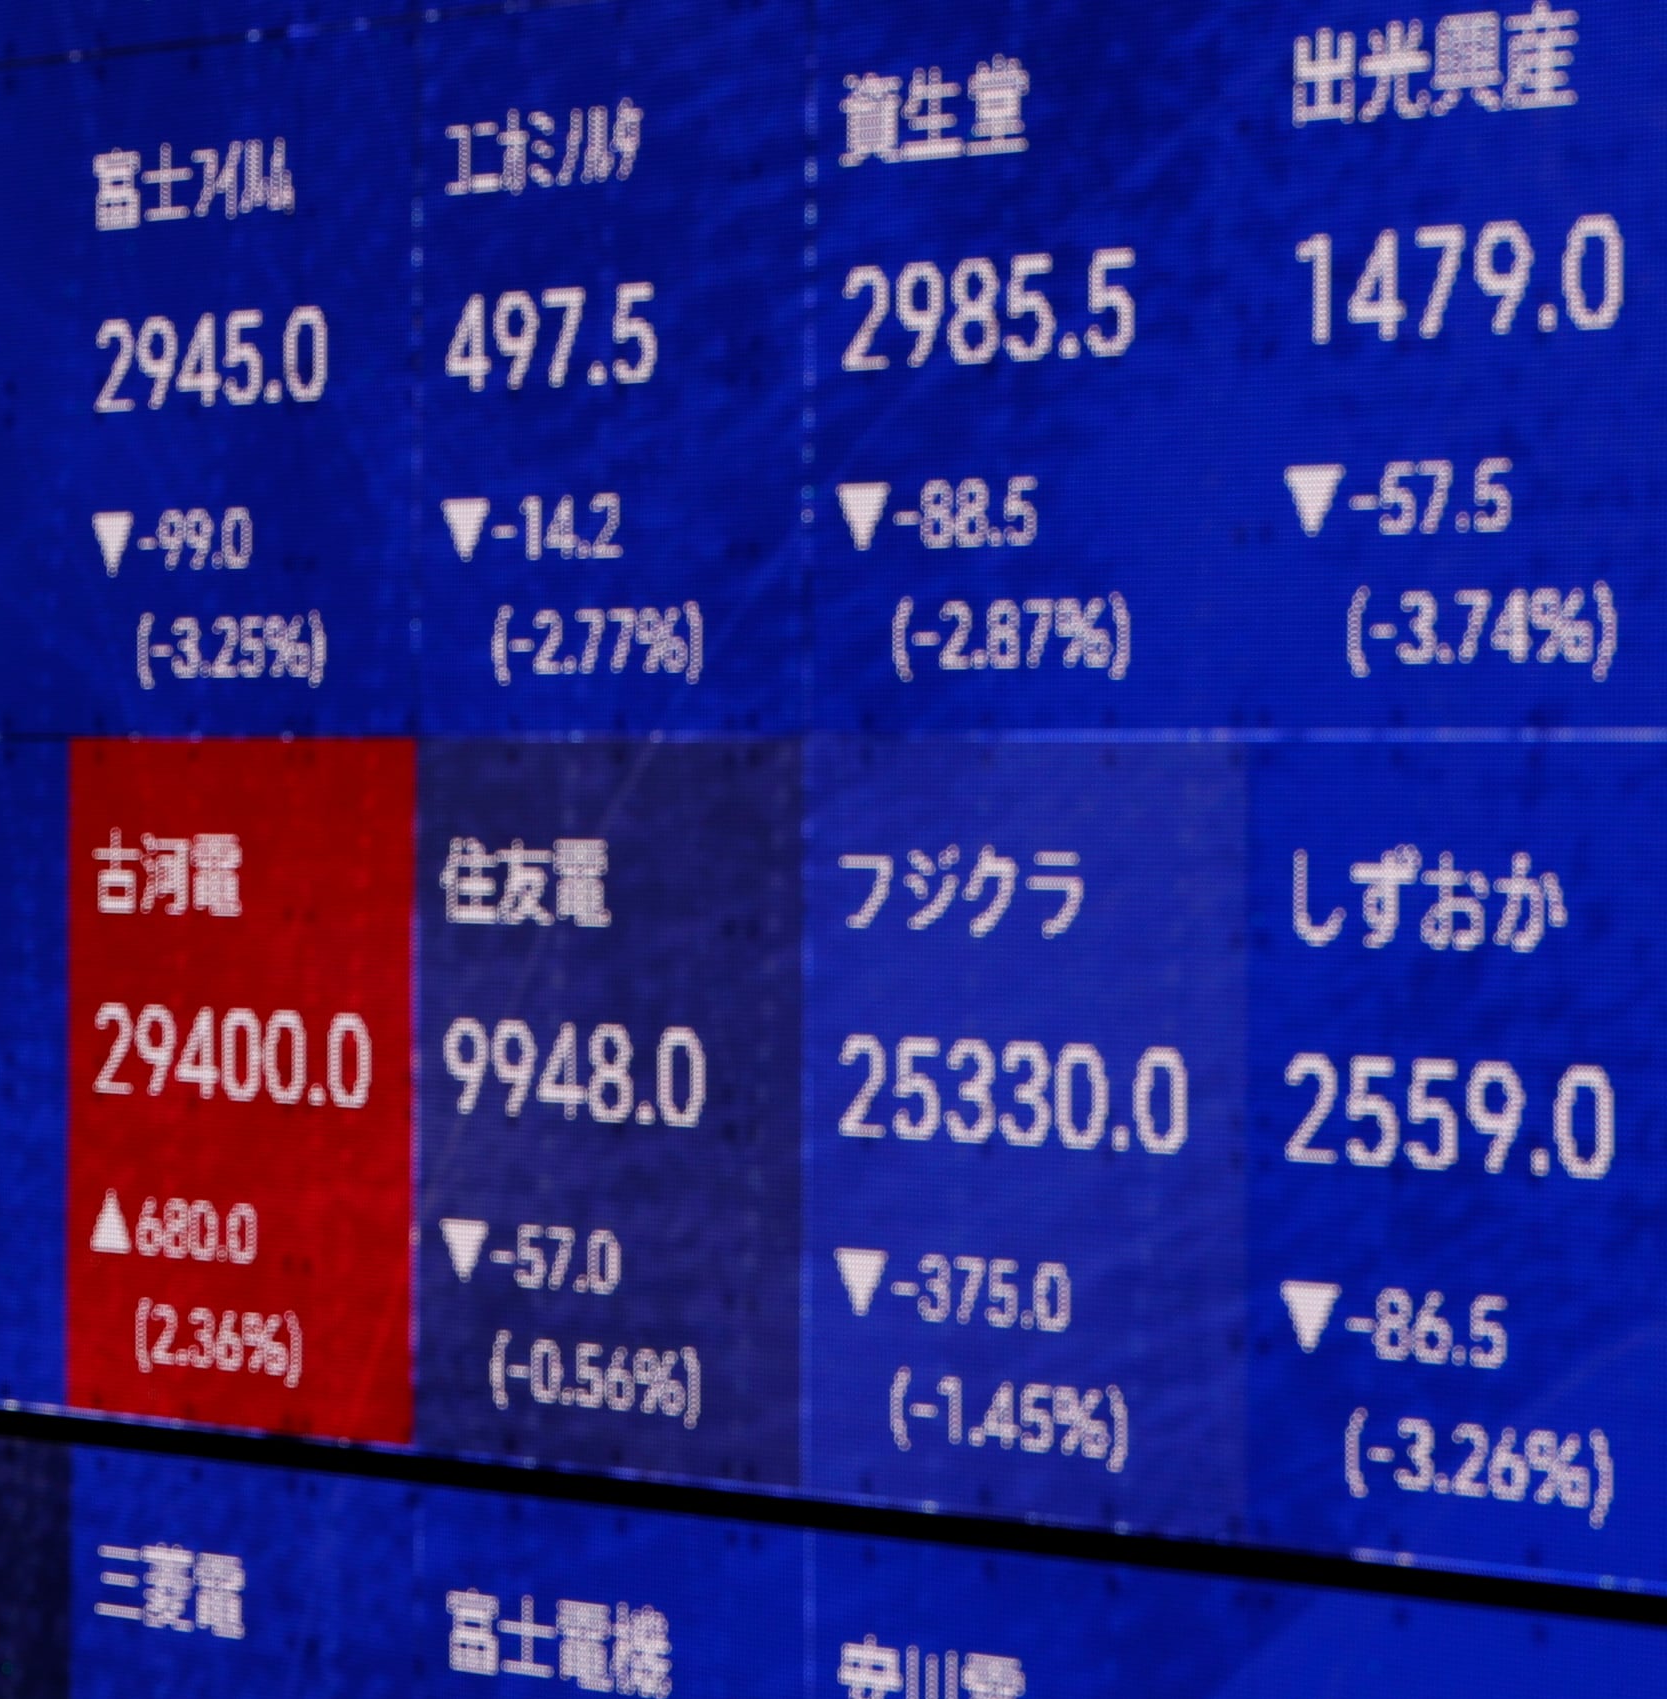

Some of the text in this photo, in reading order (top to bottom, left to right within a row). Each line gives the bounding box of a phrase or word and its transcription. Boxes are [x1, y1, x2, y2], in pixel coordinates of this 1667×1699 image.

[1293, 0, 1575, 122] 出光興産
[842, 58, 1029, 166] 資生堂
[842, 248, 1134, 371] 2985.5
[1296, 214, 1623, 344] 1479.0
[96, 306, 327, 412] 2945.0
[446, 282, 657, 392] 497.5
[140, 508, 251, 569] -99.0
[492, 493, 620, 560] -14.2
[897, 476, 1036, 548] -88.5
[1352, 458, 1511, 535] -57.5
[491, 602, 702, 681] (-2.77%)
[893, 597, 1130, 680] (-2.87%)
[1347, 584, 1617, 677] (-3.74%)
[95, 833, 241, 916] 古河電
[440, 838, 611, 927] 住友電
[840, 845, 1083, 937] フジクラ
[1294, 845, 1567, 952] しずおか
[95, 1003, 371, 1108] 29400.0
[443, 1018, 706, 1127] 9948.0
[839, 1034, 1187, 1154] 25330.0
[1285, 1053, 1614, 1179] 2559.0
[136, 1198, 256, 1264] 680.0
[493, 1224, 621, 1294] -57.0
[891, 1254, 1071, 1332] -375.0
[1347, 1289, 1506, 1368] -86.5
[136, 1298, 301, 1387] (2.36%)
[489, 1330, 700, 1424] (-0.56%)
[890, 1370, 1128, 1472] (-1.45%)
[1346, 1412, 1613, 1523] (-3.26%)
[97, 1545, 245, 1639] 三菱電
[446, 1591, 671, 1699] 富士電機
